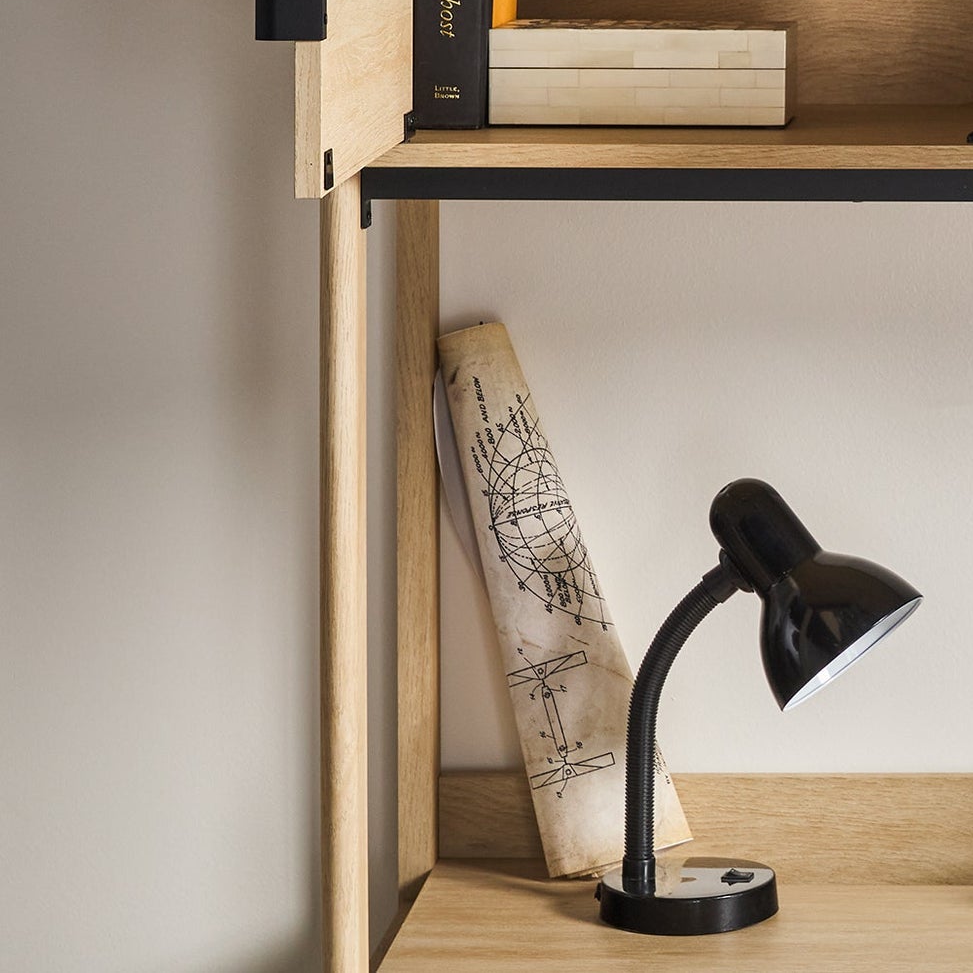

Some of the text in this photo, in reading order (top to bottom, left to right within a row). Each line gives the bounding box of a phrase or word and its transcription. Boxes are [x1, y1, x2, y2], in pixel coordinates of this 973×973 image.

[472, 376, 496, 445] 800 AND BELOW
